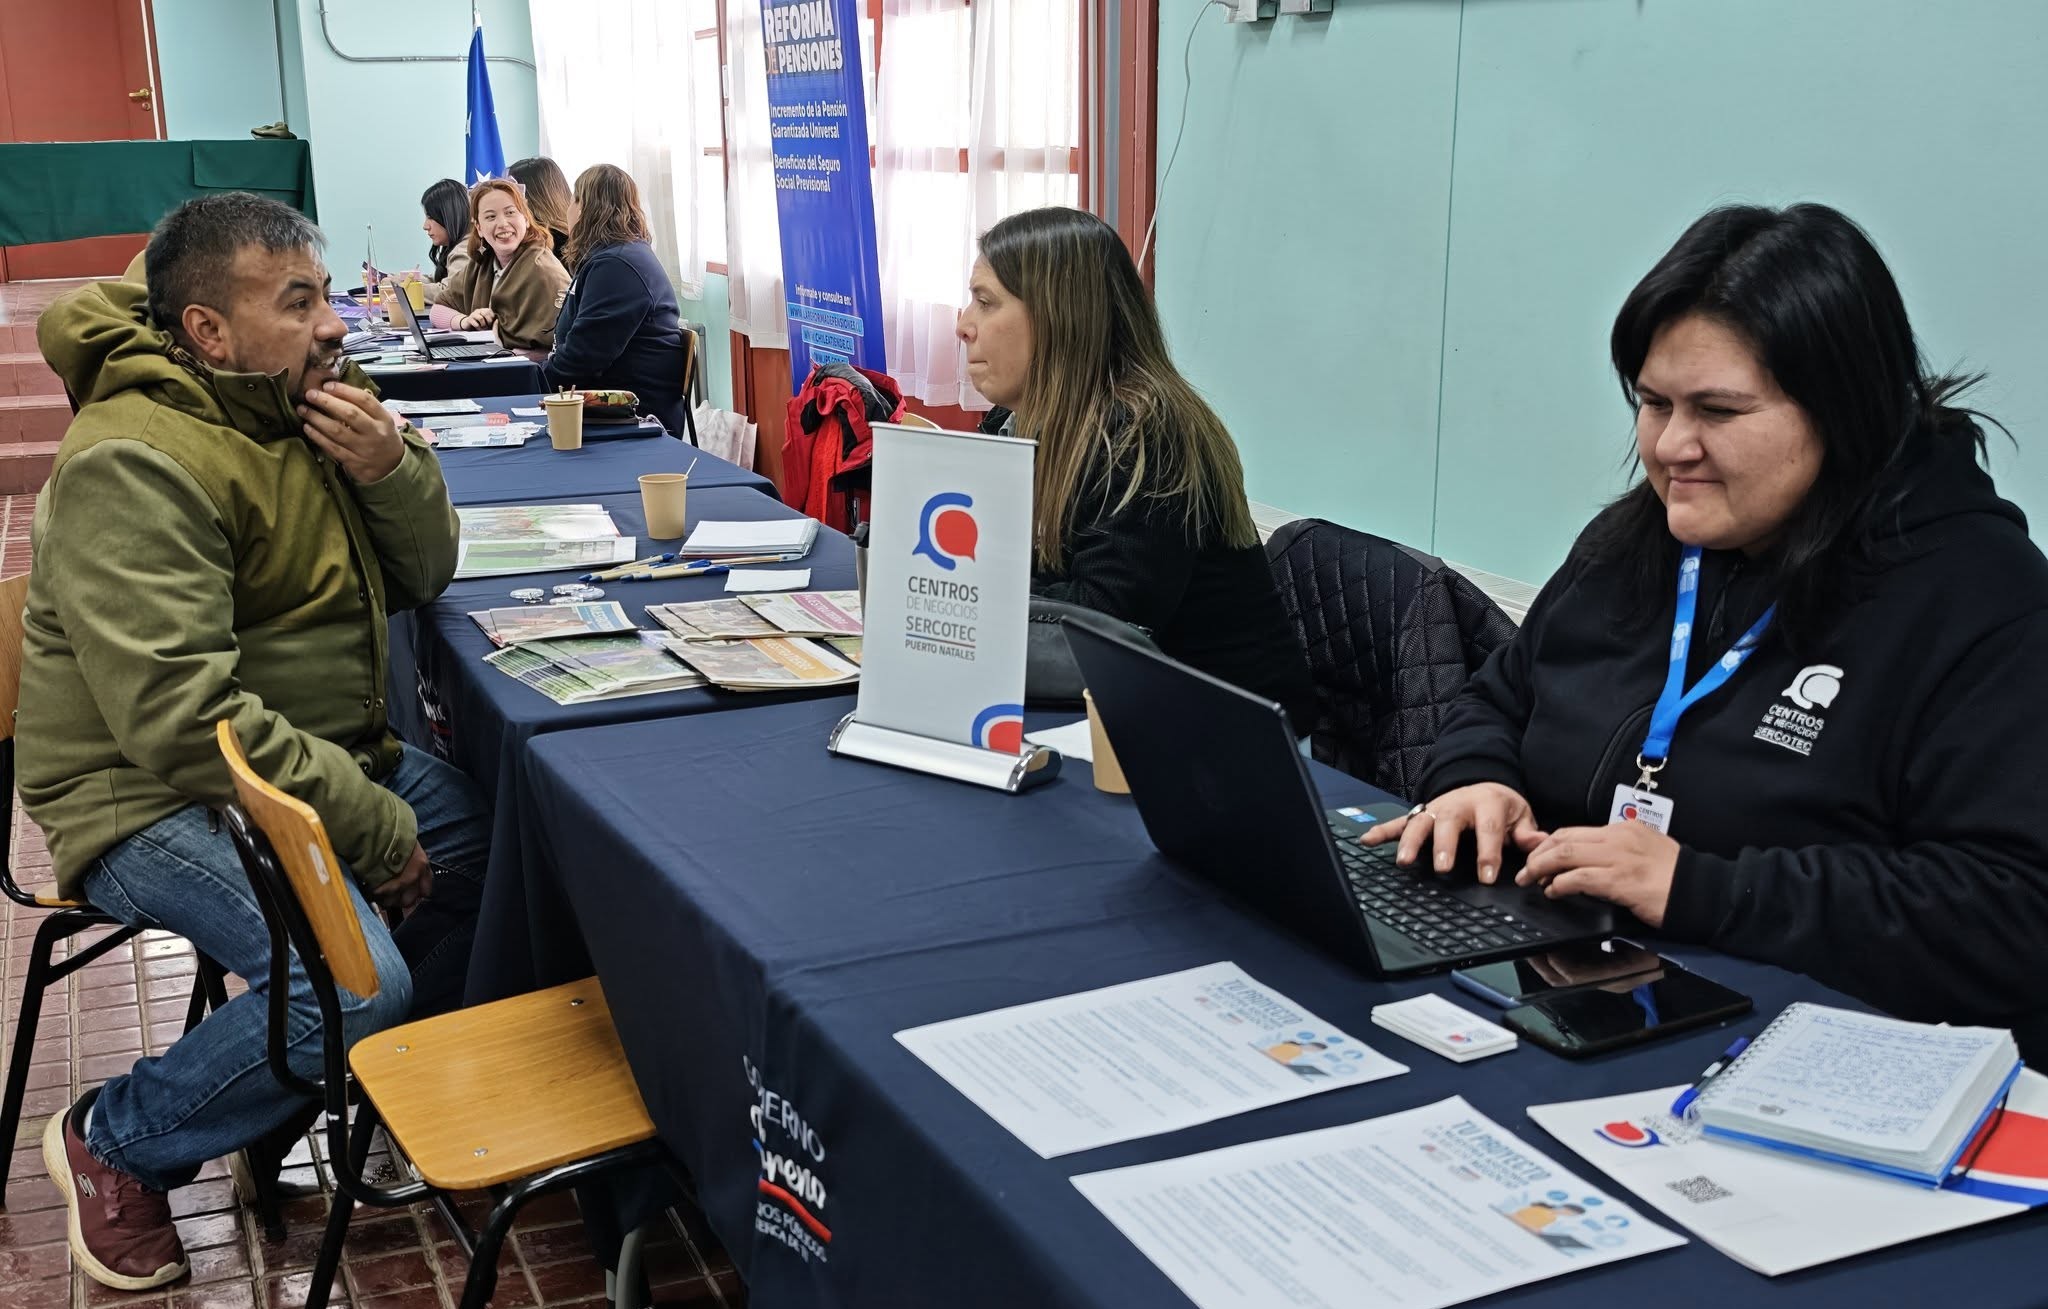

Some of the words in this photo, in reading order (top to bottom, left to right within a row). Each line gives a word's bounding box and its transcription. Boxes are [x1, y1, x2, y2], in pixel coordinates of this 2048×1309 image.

[763, 0, 835, 43] REFORMA
[765, 46, 779, 75] DE
[778, 39, 843, 74] PENSIONES
[770, 103, 806, 118] Incremento
[806, 101, 815, 118] de
[815, 101, 822, 117] la
[822, 99, 848, 117] Pensión
[772, 122, 809, 139] Garantizada
[810, 122, 840, 139] Universal
[774, 153, 807, 170] Beneficios
[807, 154, 818, 170] del
[818, 154, 841, 175] Seguro
[776, 173, 796, 189] Social
[796, 174, 831, 192] Previsional
[822, 290, 844, 305] consulta
[908, 575, 979, 603] CENTROS
[906, 595, 922, 611] DE
[922, 597, 978, 621] NEGOCIOS
[905, 615, 977, 643] SERCOTEC
[904, 639, 938, 654] PUERTO
[938, 645, 976, 662] NATALES
[1762, 714, 1774, 724] DE
[1774, 718, 1818, 739] NEGOCIOS
[1769, 704, 1824, 731] CENTROS
[1755, 726, 1812, 751] SERCOTEC
[1468, 1133, 1552, 1181] PROYECTO
